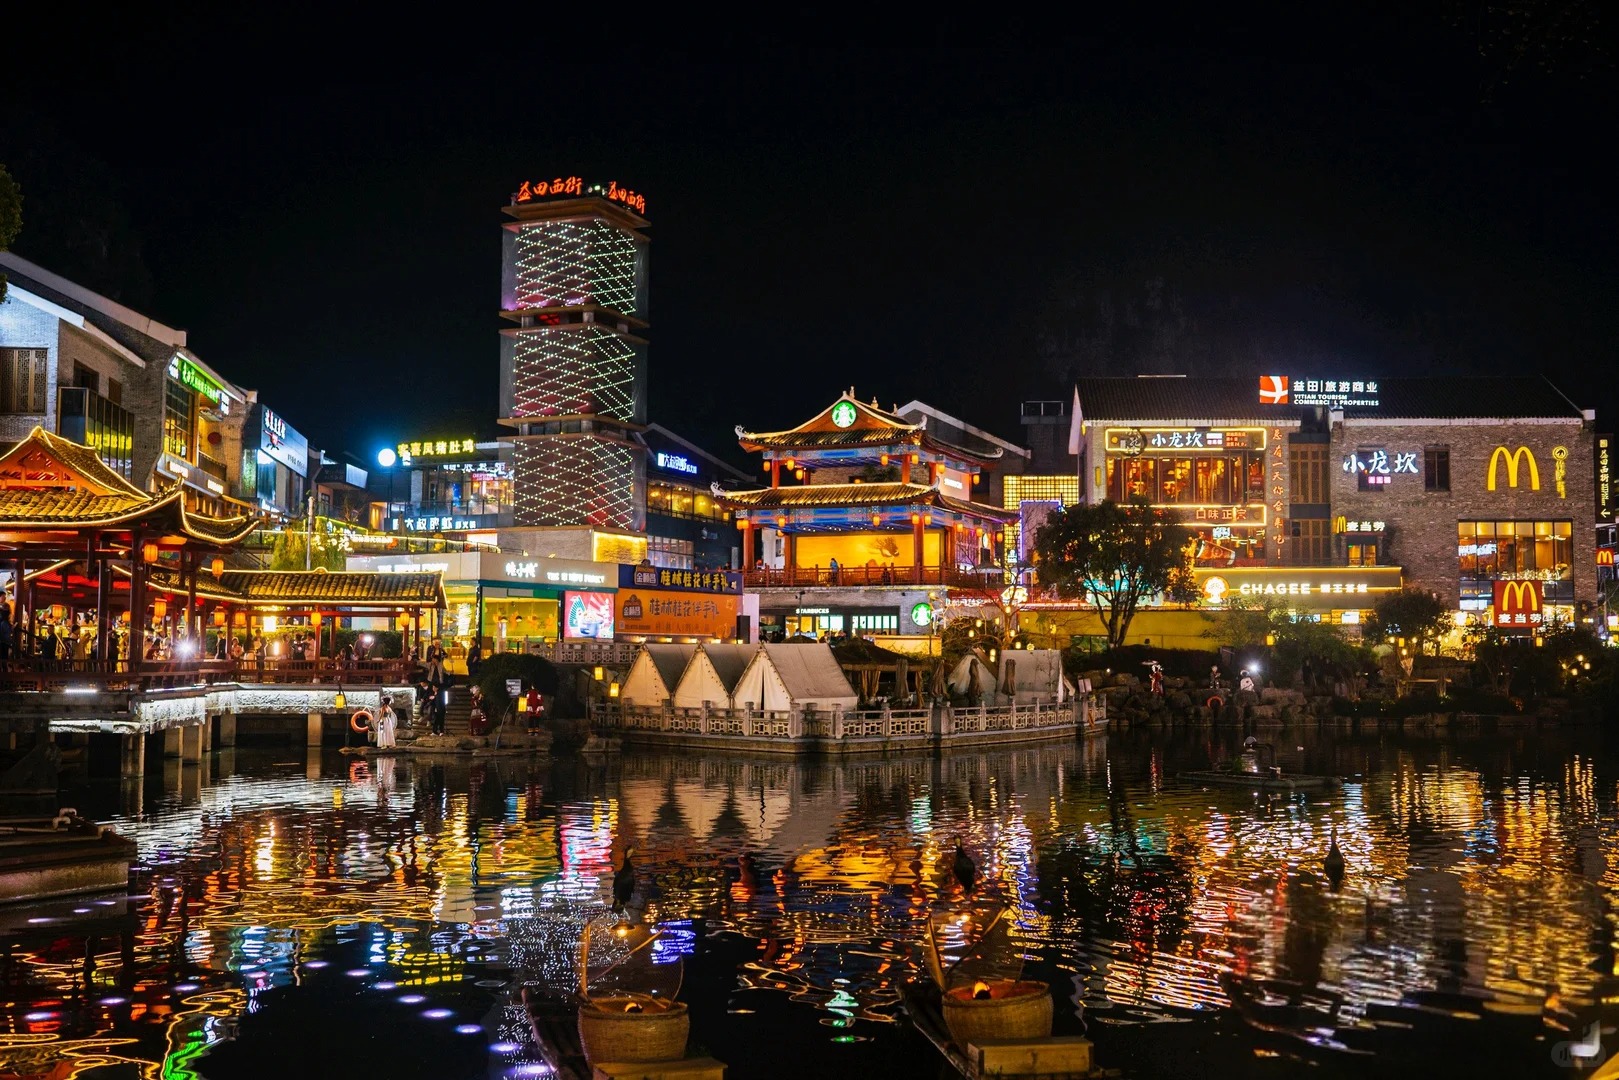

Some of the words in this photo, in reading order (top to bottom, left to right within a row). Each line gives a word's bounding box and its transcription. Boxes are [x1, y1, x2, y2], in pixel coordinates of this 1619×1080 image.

[517, 176, 583, 201] 益田西街
[607, 181, 645, 214] 益田西街
[1151, 431, 1204, 448] 小龙坎
[1342, 450, 1419, 474] 小龙坎
[1346, 521, 1386, 532] 麦当劳
[660, 569, 729, 592] 桂林桂花伴手礼
[1239, 583, 1311, 595] CHAGEE
[649, 598, 720, 620] 桂林桂花伴手礼
[1498, 613, 1542, 624] 麦当劳
